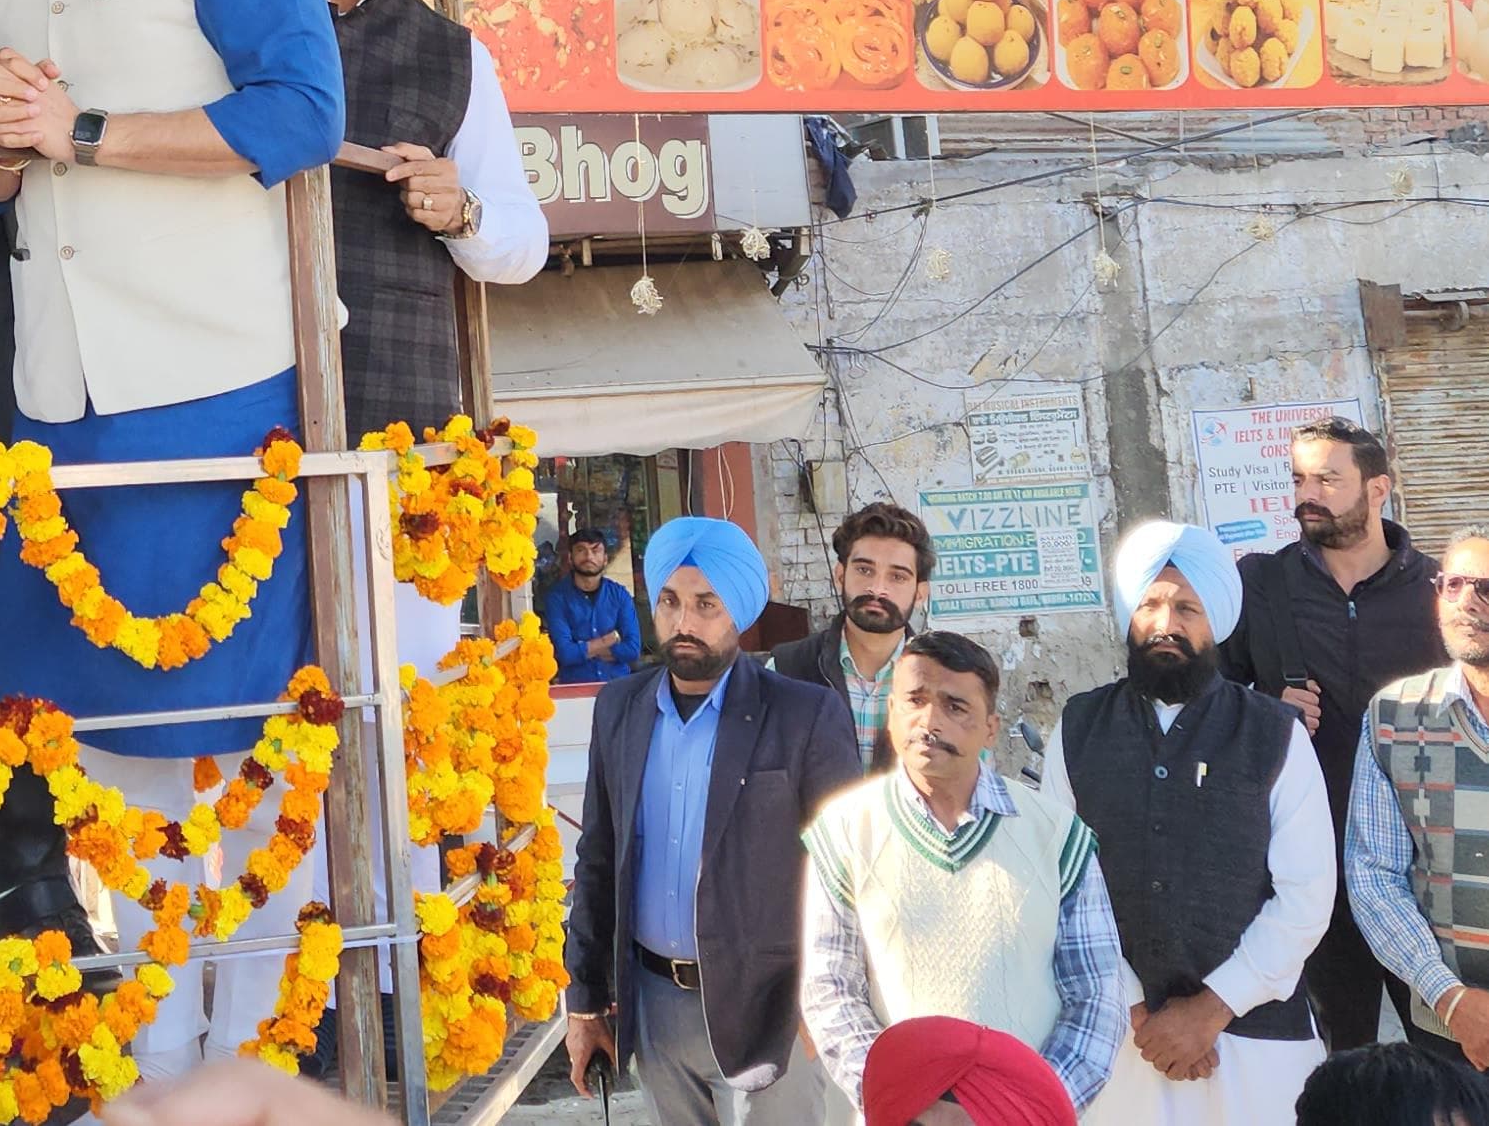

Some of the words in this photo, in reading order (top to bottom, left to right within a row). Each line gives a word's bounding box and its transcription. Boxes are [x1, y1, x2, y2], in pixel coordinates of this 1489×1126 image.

[511, 125, 707, 218] Bhog
[1251, 411, 1271, 424] THE
[1235, 429, 1263, 443] IELTS
[1209, 466, 1241, 479] Study
[1244, 464, 1269, 476] Visa
[1214, 482, 1237, 494] PTE
[1251, 480, 1289, 491] Visitor
[938, 583, 972, 595] TOLL
[974, 580, 1008, 592] FREE
[1012, 578, 1038, 591] 1800
